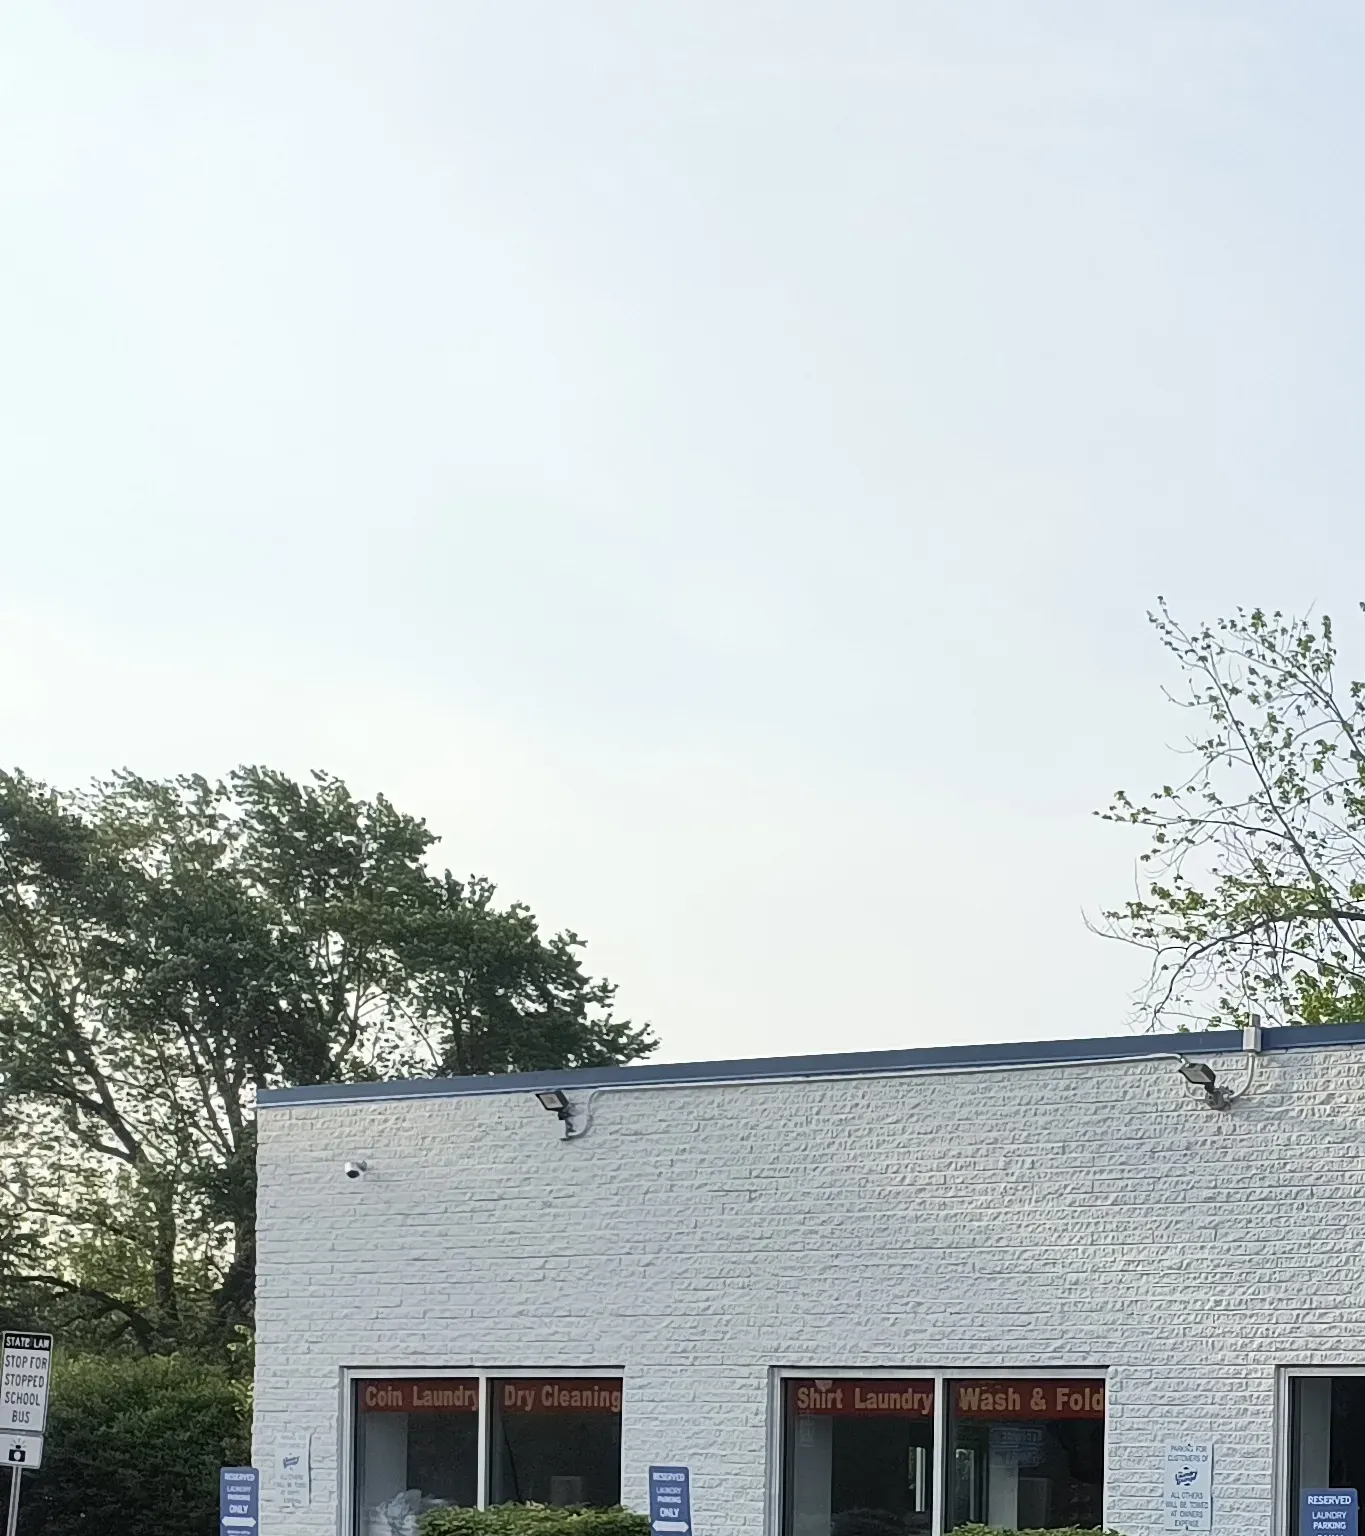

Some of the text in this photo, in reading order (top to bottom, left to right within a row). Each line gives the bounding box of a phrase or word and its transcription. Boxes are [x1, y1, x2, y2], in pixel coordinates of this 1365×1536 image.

[6, 1336, 50, 1349] STATE LAW
[5, 1354, 48, 1369] STOP FOR
[5, 1374, 45, 1388] STOPPED
[5, 1391, 41, 1406] SCHOOL
[365, 1385, 478, 1411] Coin Laundry
[504, 1384, 621, 1412] Dry Cleaning
[797, 1386, 933, 1414] Shirt Laundry
[959, 1387, 1103, 1411] Wash & Fold
[12, 1410, 31, 1424] BUS
[1307, 1495, 1352, 1505] RESERVED
[660, 1507, 680, 1518] ONLY
[1312, 1511, 1347, 1520] LAUNDRY
[1313, 1521, 1347, 1530] PARKING
